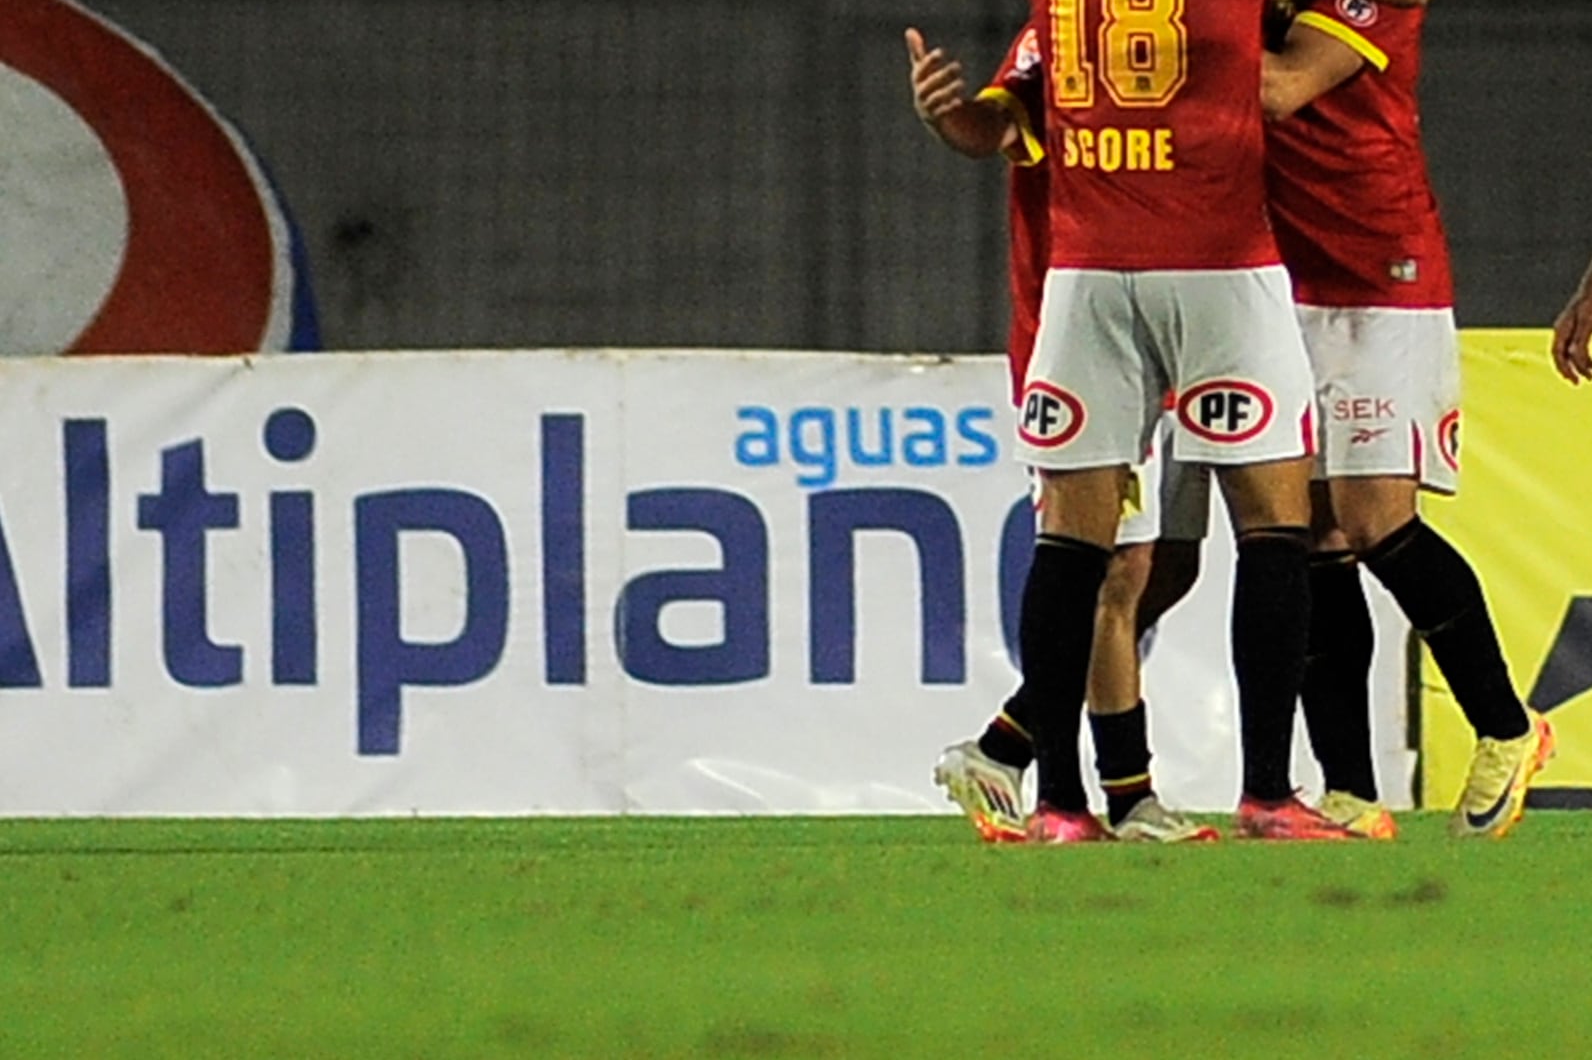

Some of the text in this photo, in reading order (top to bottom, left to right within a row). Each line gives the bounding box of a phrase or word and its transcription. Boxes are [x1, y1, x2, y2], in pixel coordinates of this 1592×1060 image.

[1063, 127, 1174, 171] SCORE
[1024, 392, 1061, 436] PF
[1200, 390, 1252, 433] PF
[1333, 397, 1396, 421] SEK
[735, 406, 997, 486] aguas
[0, 407, 1038, 756] ltiplan
